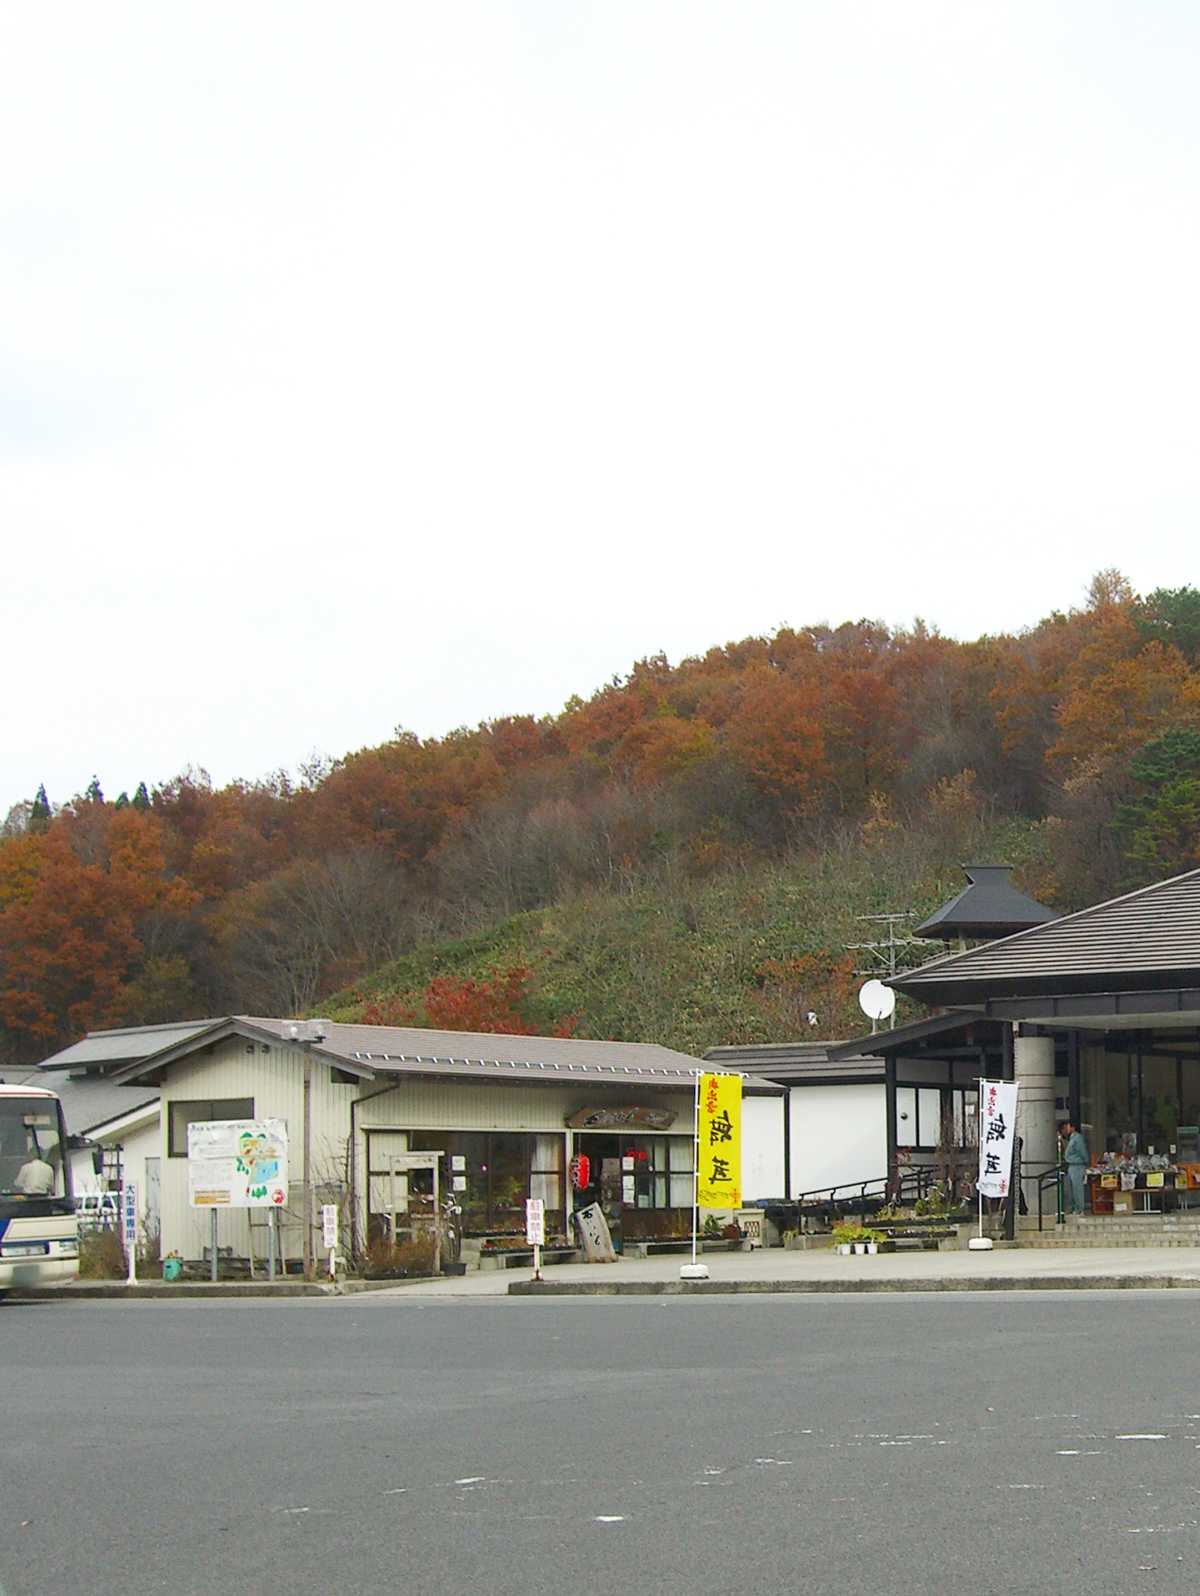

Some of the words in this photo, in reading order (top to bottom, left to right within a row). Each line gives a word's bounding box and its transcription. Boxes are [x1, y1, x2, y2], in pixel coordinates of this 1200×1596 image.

[125, 1184, 136, 1241] 大型車専用
[326, 1207, 335, 1246] 駐車禁止
[530, 1201, 541, 1243] 駐車禁止
